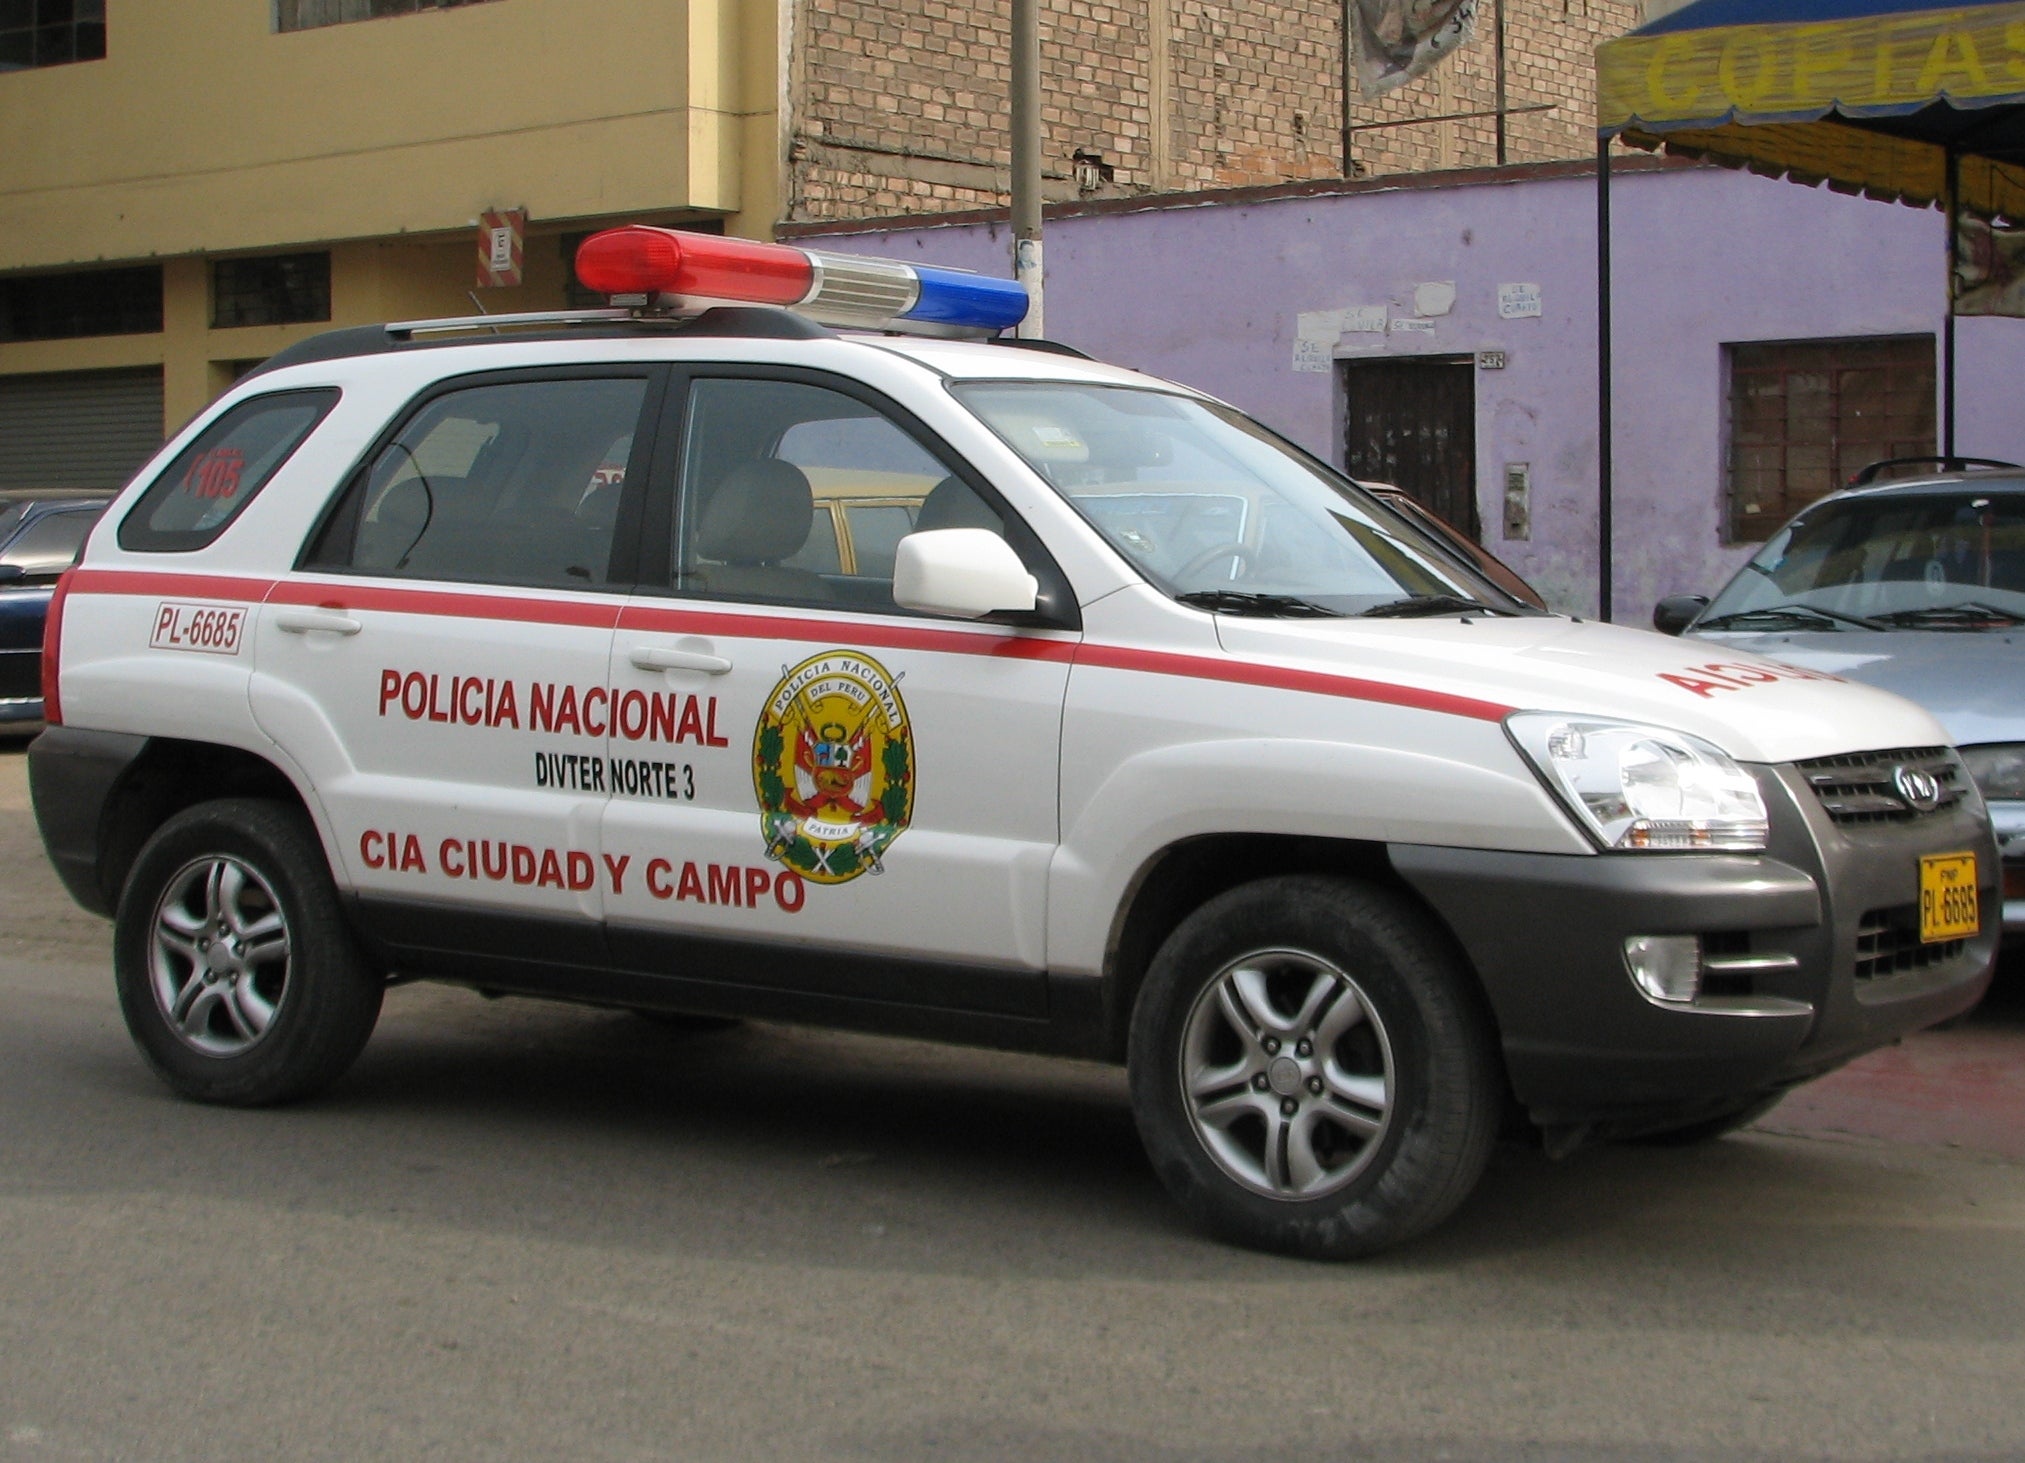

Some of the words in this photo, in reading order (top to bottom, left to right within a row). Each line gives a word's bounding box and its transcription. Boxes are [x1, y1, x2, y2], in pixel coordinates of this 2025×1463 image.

[195, 460, 245, 498] 105
[155, 607, 240, 648] PL-6685
[379, 669, 520, 730] POLICIA
[529, 682, 729, 748] NACIONAL
[775, 661, 831, 711] POLICIA
[840, 660, 899, 722] NACIONAL
[810, 682, 832, 698] DEL
[535, 752, 605, 792] DIVTER
[609, 758, 678, 799] NORTE
[683, 764, 695, 801] 3
[808, 823, 849, 836] PATRIA
[360, 829, 427, 874] CIA
[439, 838, 596, 892] CIUDAD
[602, 853, 631, 894] Y
[646, 858, 805, 914] CAMPO
